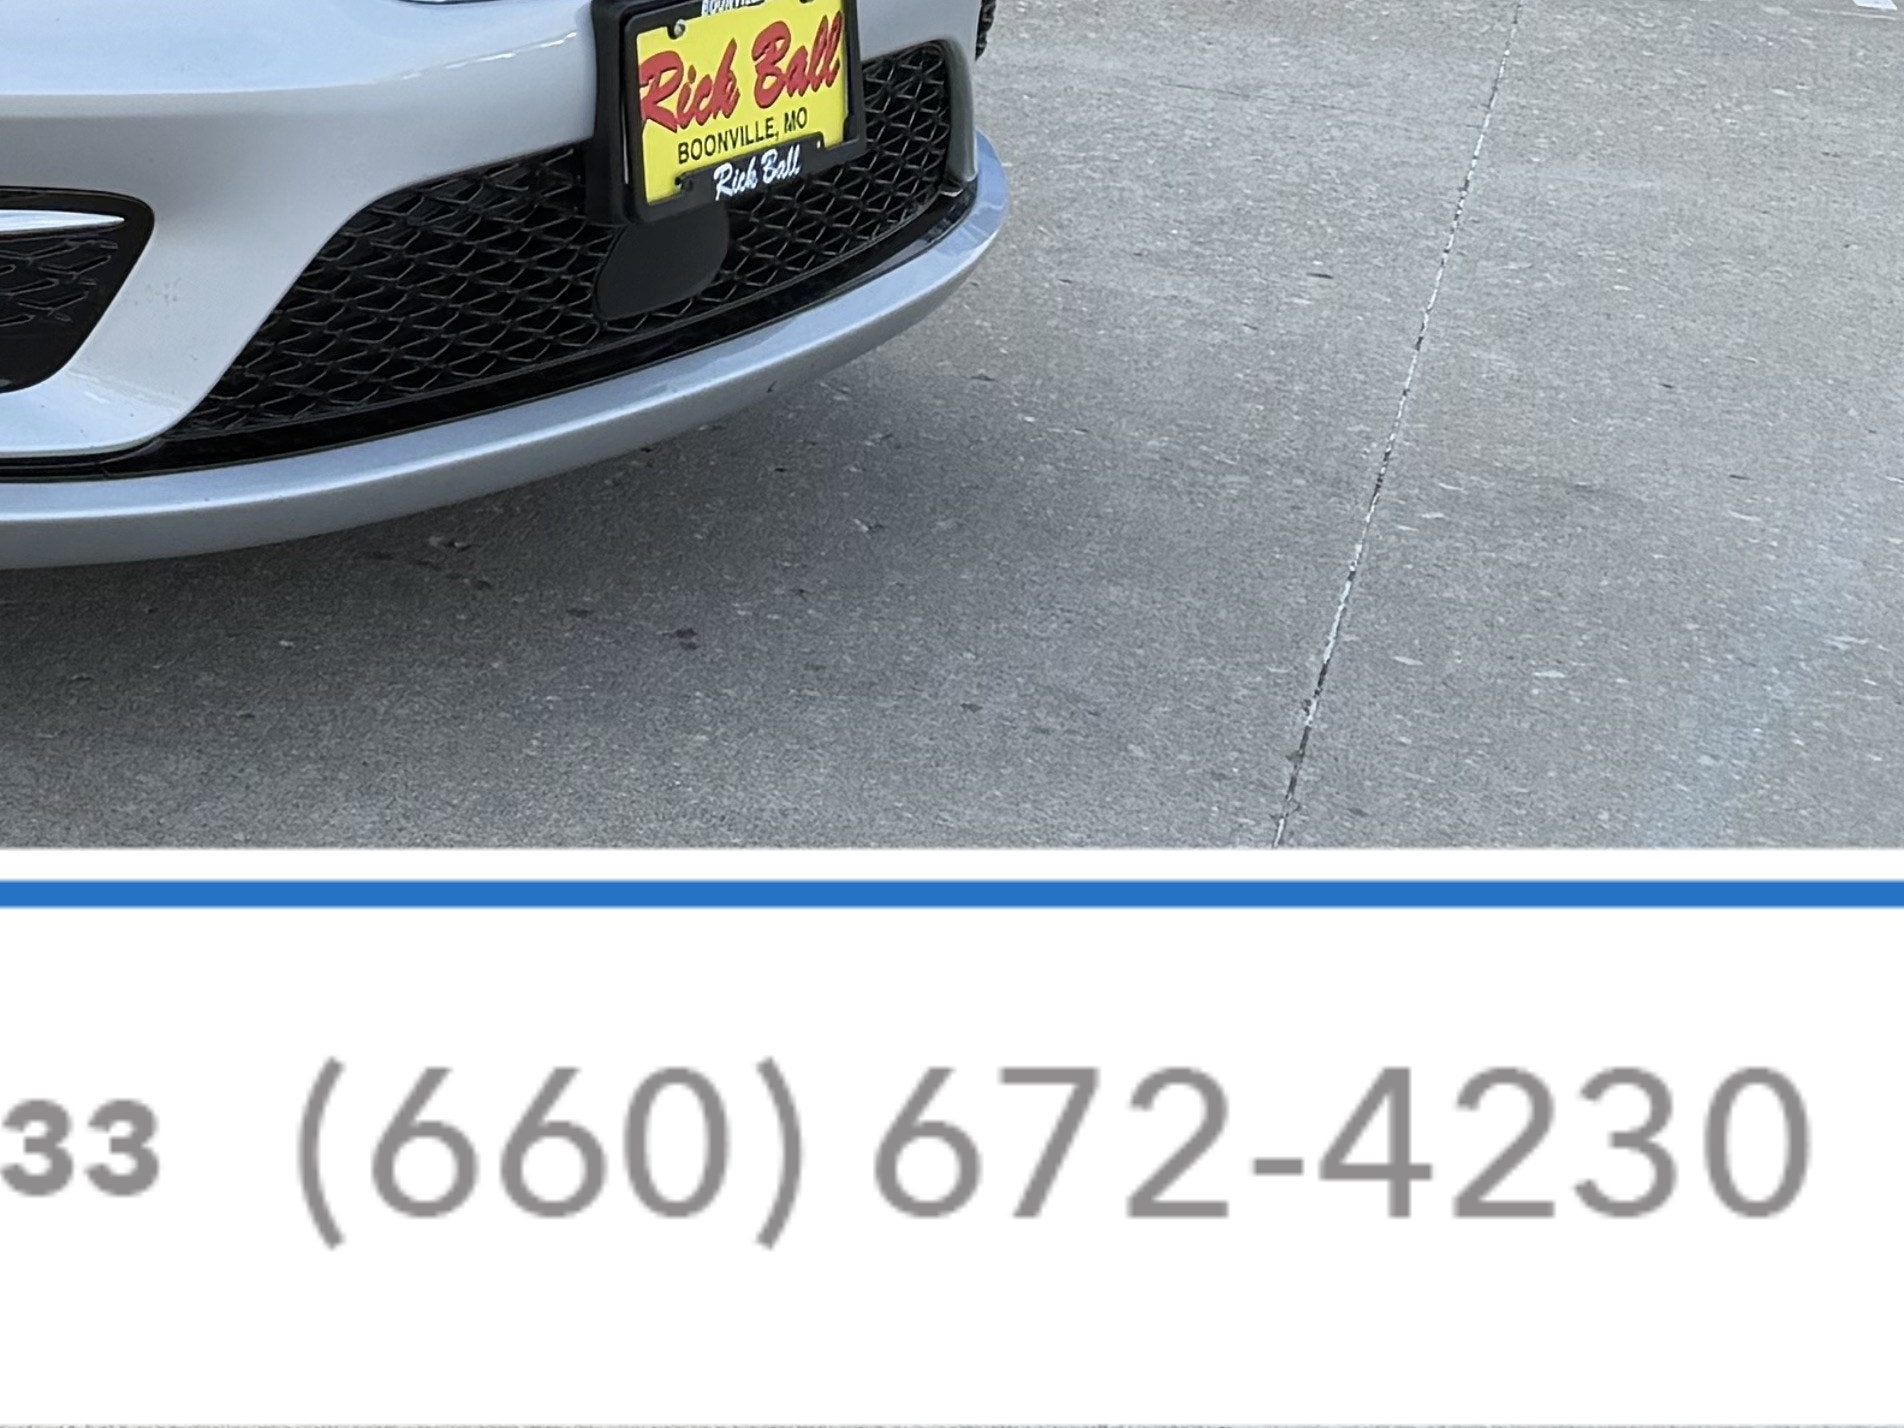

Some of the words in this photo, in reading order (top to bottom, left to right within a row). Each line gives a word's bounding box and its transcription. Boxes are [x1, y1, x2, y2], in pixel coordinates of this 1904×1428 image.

[638, 38, 741, 133] Rick
[752, 10, 844, 109] Ball
[678, 117, 780, 164] BOONVILLE,
[784, 107, 808, 134] MO
[713, 156, 759, 201] Rick
[760, 143, 802, 185] Ball
